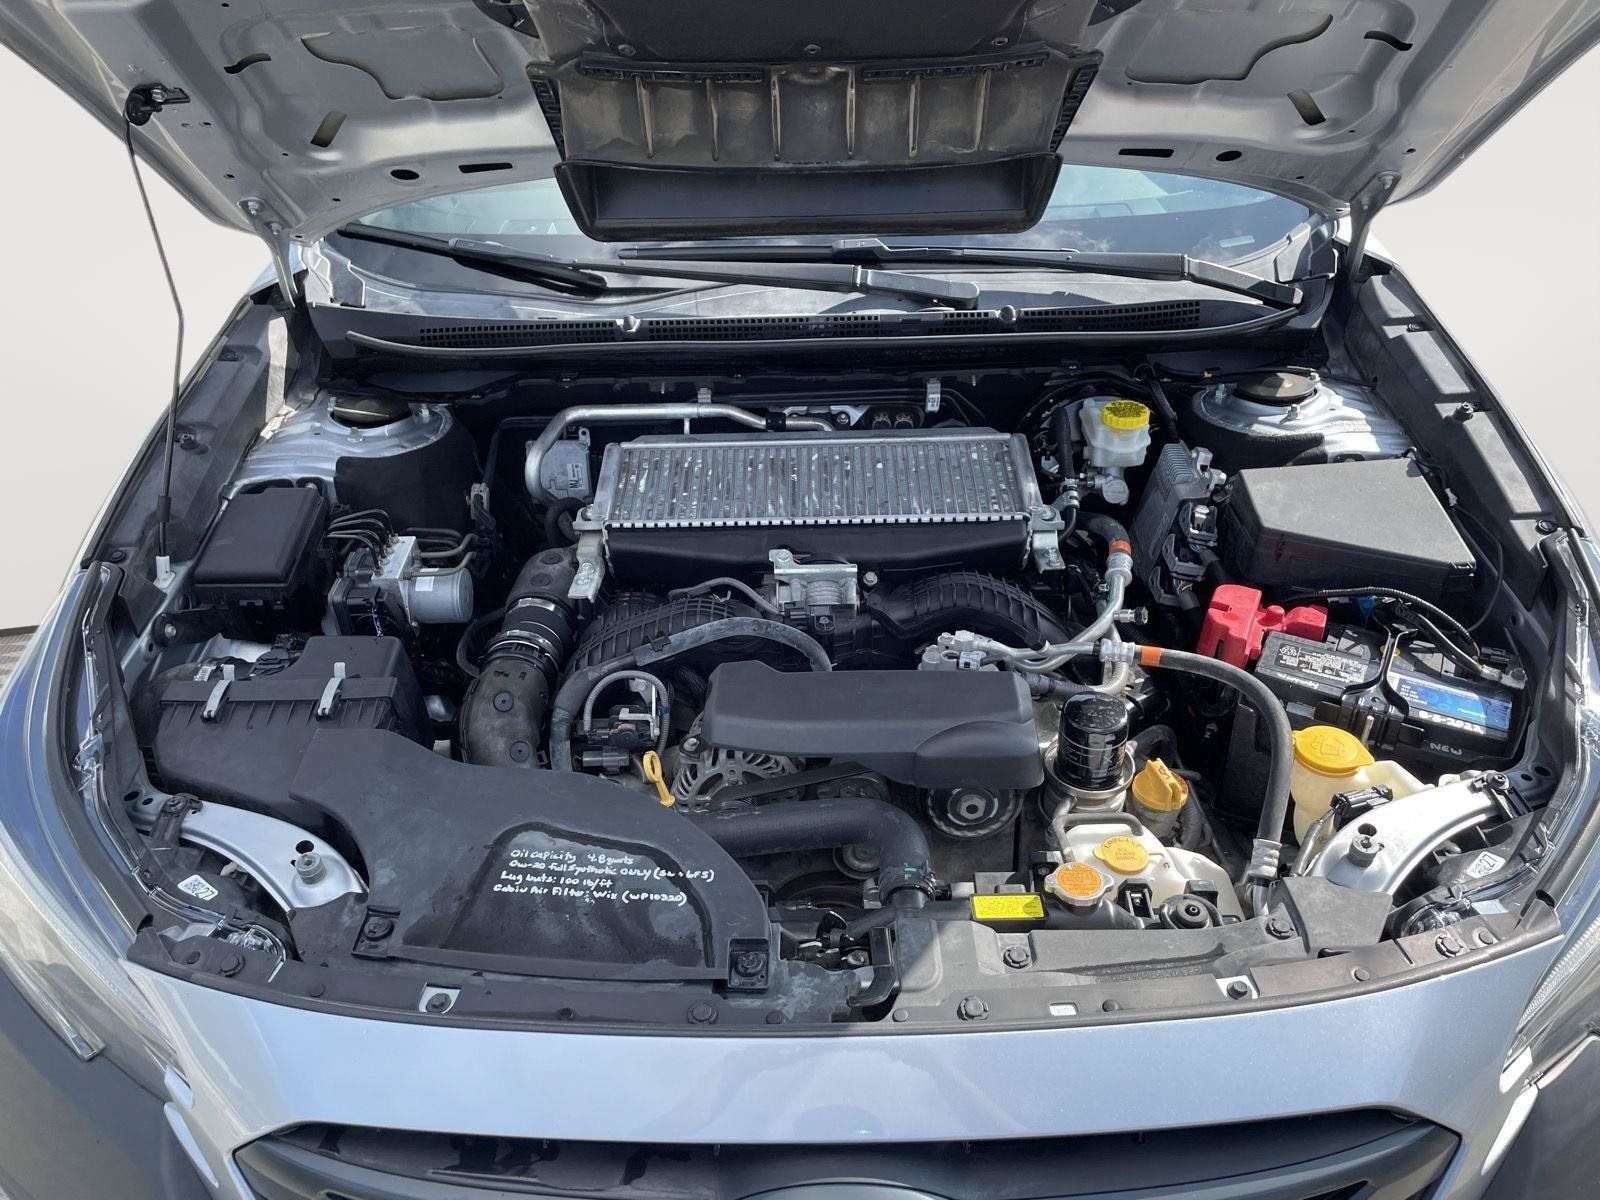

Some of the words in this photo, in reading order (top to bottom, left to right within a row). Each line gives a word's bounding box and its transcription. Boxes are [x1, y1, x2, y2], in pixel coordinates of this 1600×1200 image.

[510, 849, 529, 858] Oil
[500, 870, 523, 885] Lug
[559, 876, 580, 885] 100
[582, 878, 613, 890] lb/ft
[529, 885, 549, 894] Air
